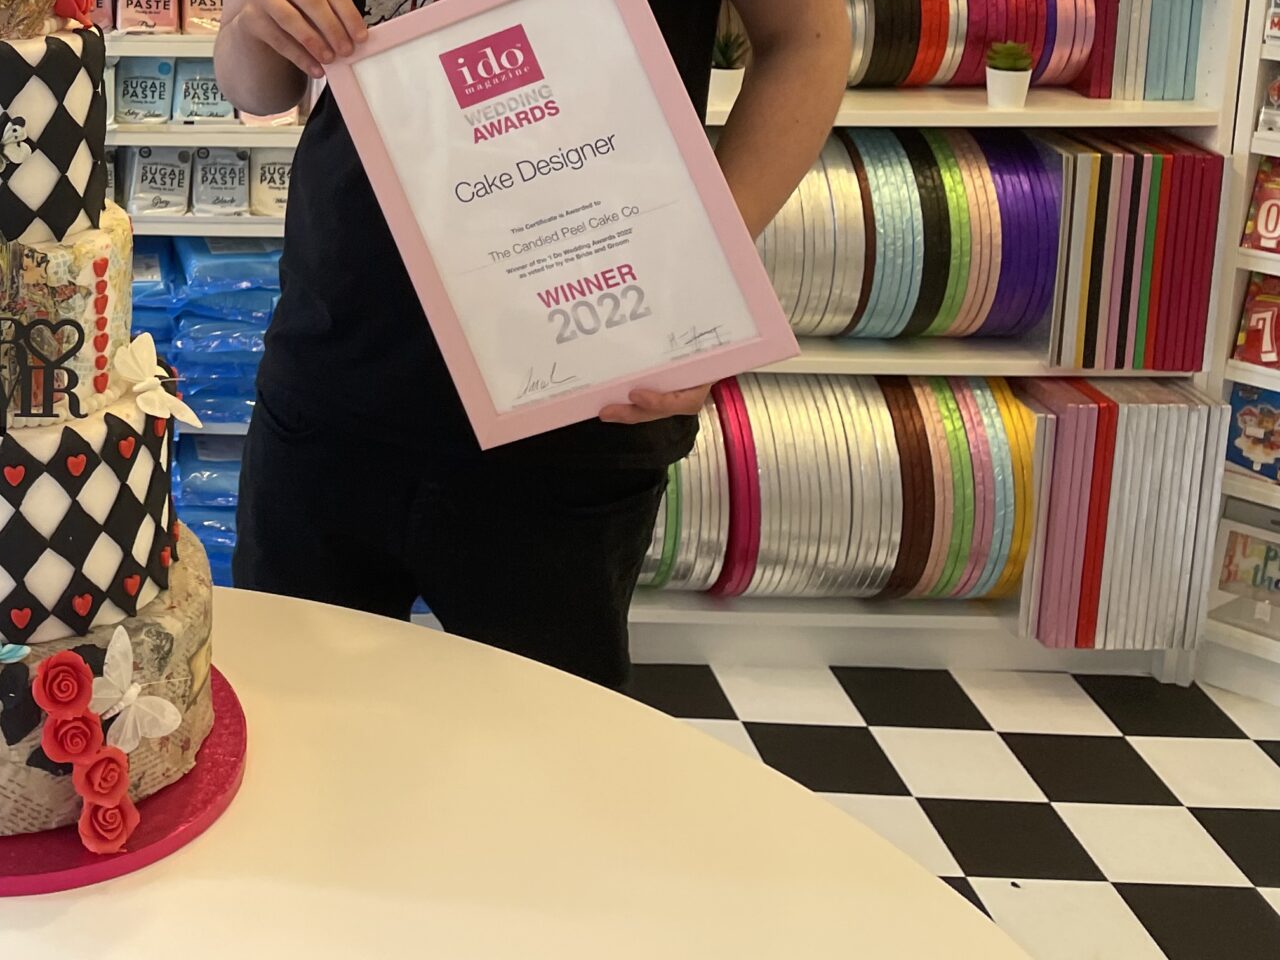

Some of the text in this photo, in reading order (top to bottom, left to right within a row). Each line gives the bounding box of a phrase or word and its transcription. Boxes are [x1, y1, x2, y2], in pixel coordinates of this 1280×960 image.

[126, 0, 171, 10] PASTE
[122, 90, 166, 100] PASTE
[123, 80, 166, 90] SUGAR
[184, 81, 219, 91] SUGA
[464, 65, 531, 96] magazine
[464, 85, 554, 127] WEDDING
[473, 100, 560, 145] AWARDS
[141, 166, 185, 177] SUGAR
[141, 175, 185, 188] PASTE
[201, 166, 245, 177] SUGAR
[201, 176, 245, 186] PASTE
[454, 134, 616, 203] Cake Designer
[488, 205, 640, 263] The Candied Peel Cake Co
[510, 226, 525, 235] This
[525, 215, 558, 230] Certificate
[565, 203, 593, 216] Awarded
[506, 261, 528, 275] Winner
[528, 259, 536, 267] of
[536, 257, 548, 265] the
[563, 242, 592, 256] Wedding
[592, 234, 616, 246] Awards
[528, 266, 546, 277] voted
[546, 262, 555, 271] for
[564, 256, 575, 264] the
[575, 250, 594, 260] Bride
[594, 246, 607, 254] and
[607, 238, 630, 250] Groom
[536, 263, 638, 309] WINNER
[547, 284, 652, 345] 2022
[1249, 308, 1277, 356] 7
